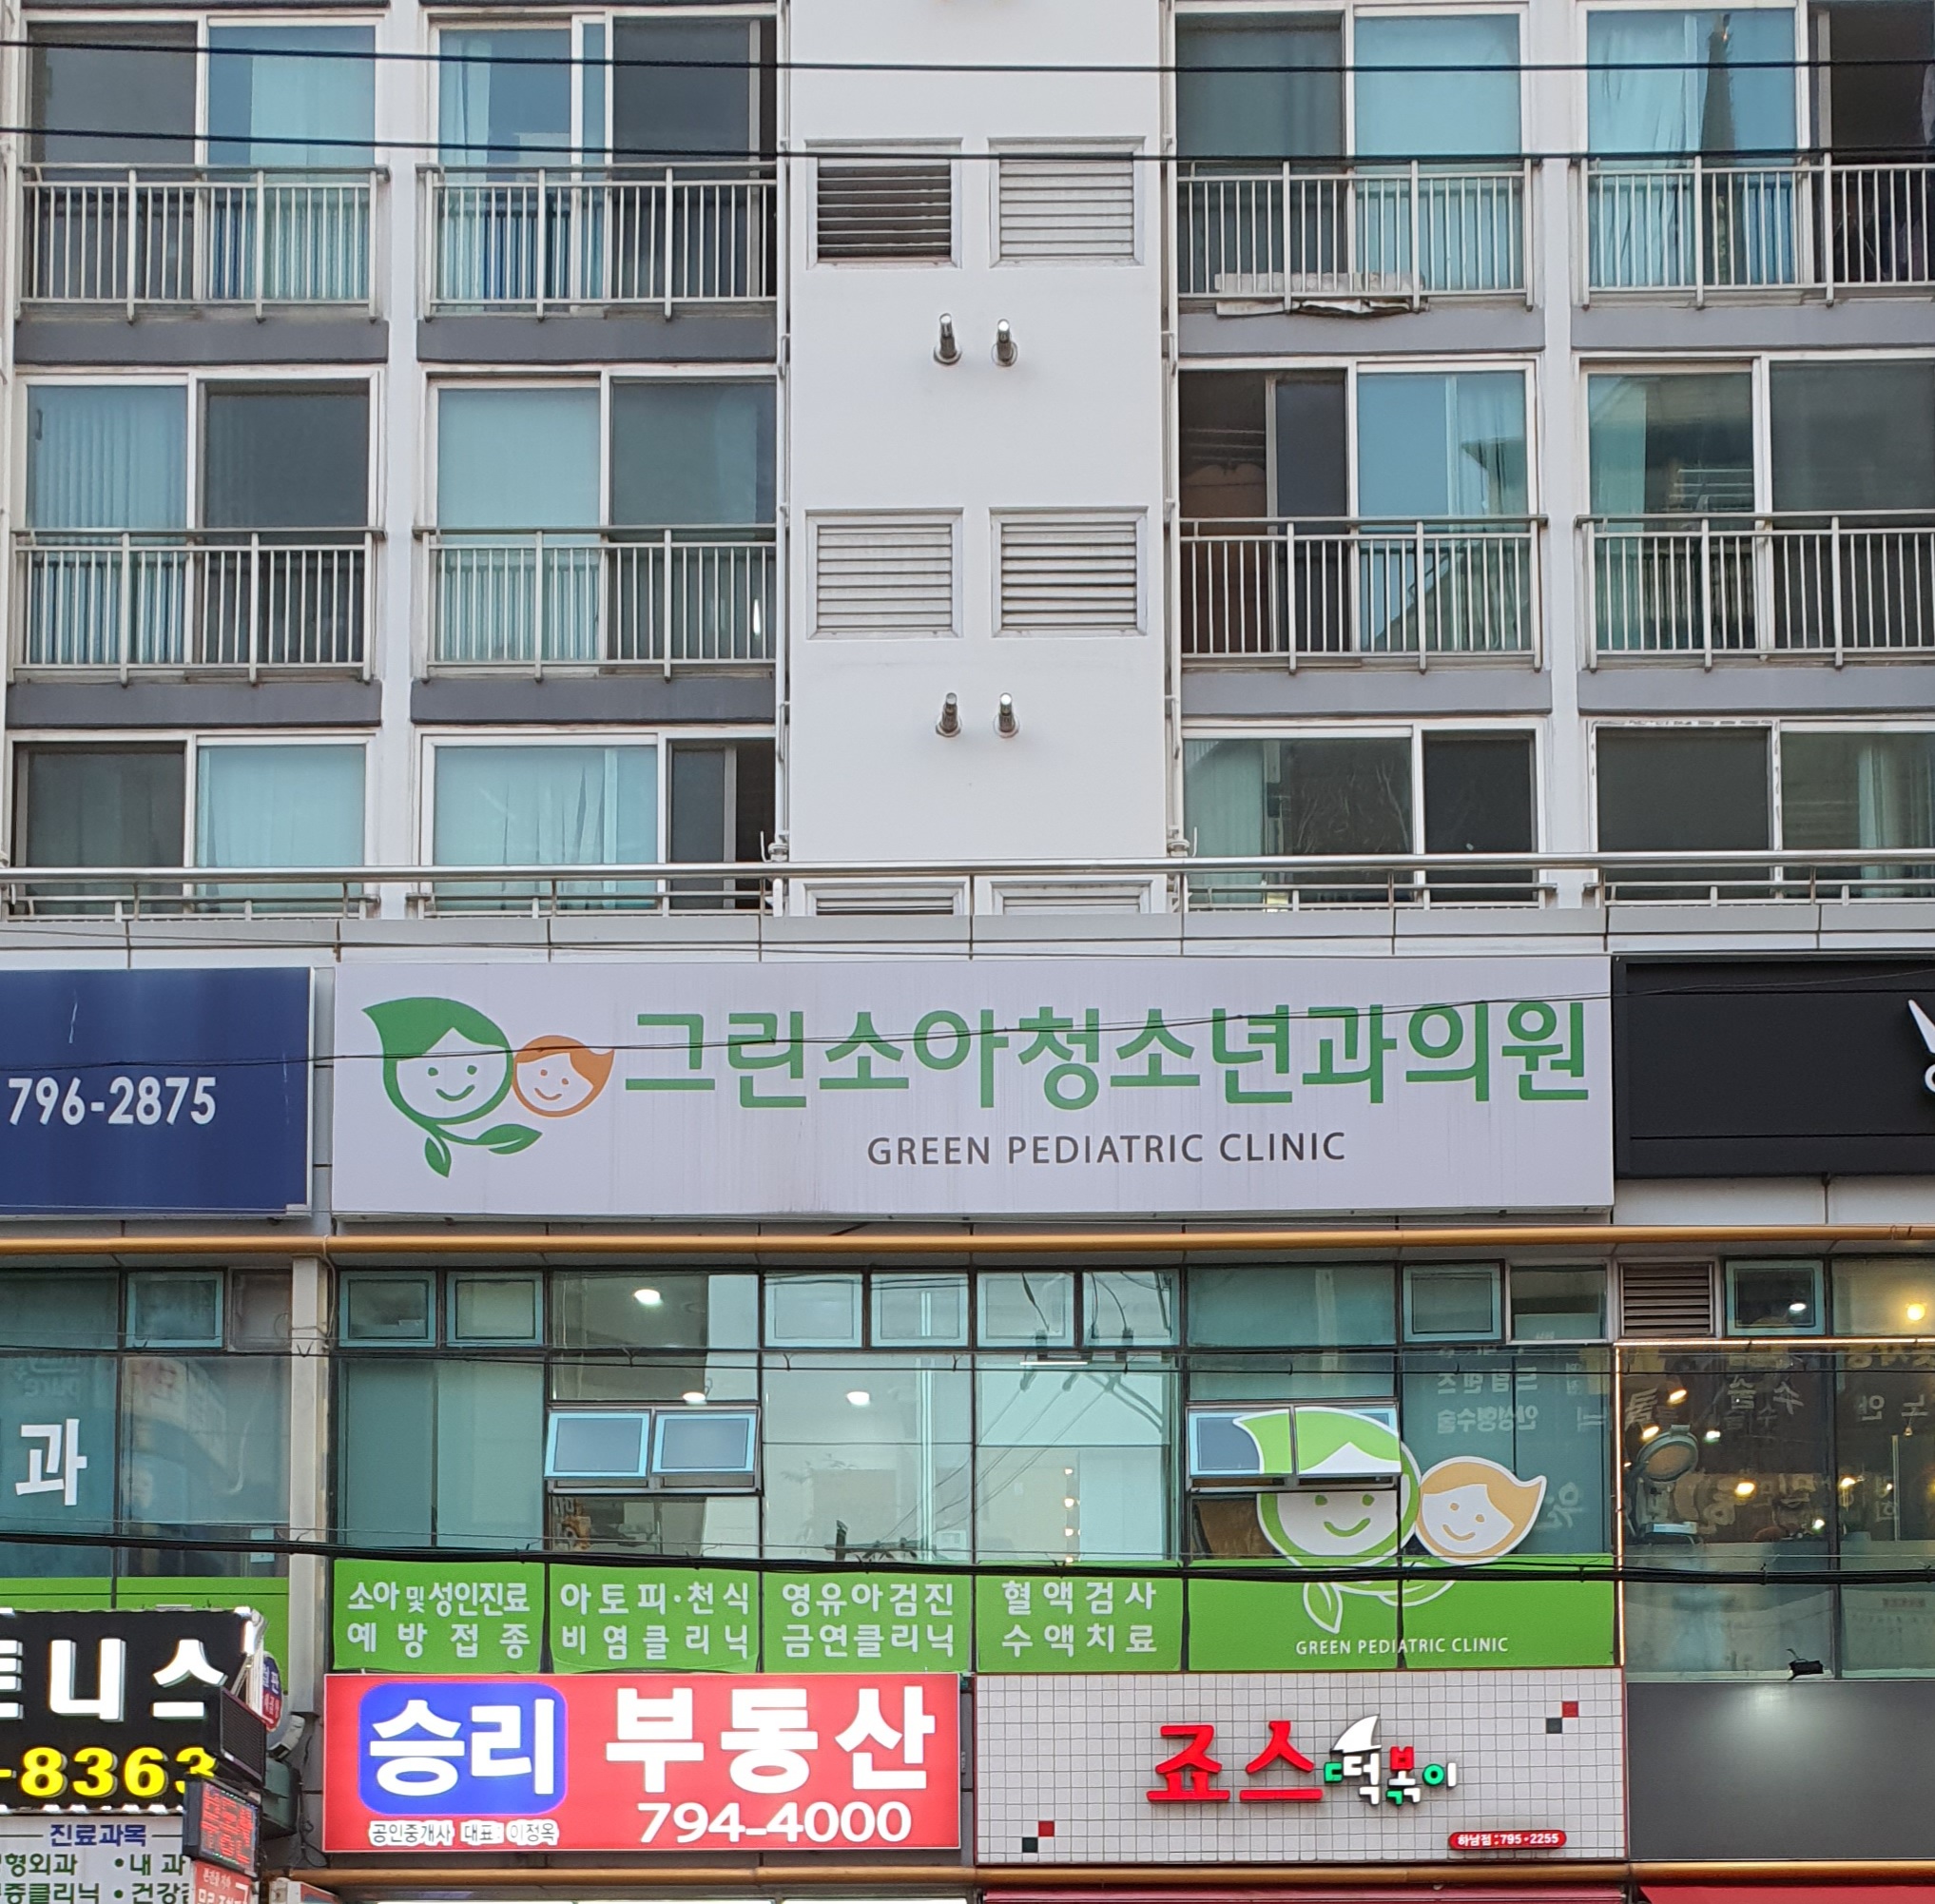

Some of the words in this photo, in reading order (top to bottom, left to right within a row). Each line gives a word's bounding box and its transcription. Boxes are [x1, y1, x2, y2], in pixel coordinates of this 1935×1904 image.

[626, 1001, 1589, 1110] 그린소아청소년과의원
[9, 1076, 217, 1126] 796-2875
[867, 1137, 990, 1165] GREEN
[1009, 1135, 1203, 1164] PEDIATRIC
[1219, 1132, 1345, 1161] CLINIC
[15, 1418, 87, 1506] 과
[347, 1582, 400, 1611] 소아
[405, 1585, 425, 1613] 및
[428, 1583, 531, 1613] 성인진료
[782, 1583, 954, 1617] 영유아검진
[1001, 1581, 1156, 1616] 혈액검사
[562, 1624, 749, 1661] 비염클리닉
[782, 1624, 954, 1658] 금연클리닉
[1001, 1623, 1157, 1657] 수액치료
[1295, 1640, 1351, 1656] GREEN
[1357, 1639, 1446, 1655] PEDIATRIC
[1451, 1637, 1509, 1653] CLINIC
[369, 1697, 556, 1797] 승리
[606, 1686, 936, 1796] 부동산
[1146, 1719, 1325, 1805] 죠스
[49, 1824, 147, 1847] 진료과목
[372, 1824, 451, 1843] 공인중개사
[510, 1821, 555, 1842] 이정옥
[636, 1800, 912, 1844] 794-4000
[0, 1853, 78, 1877] 형외과
[0, 1882, 100, 1904] 증클리닉
